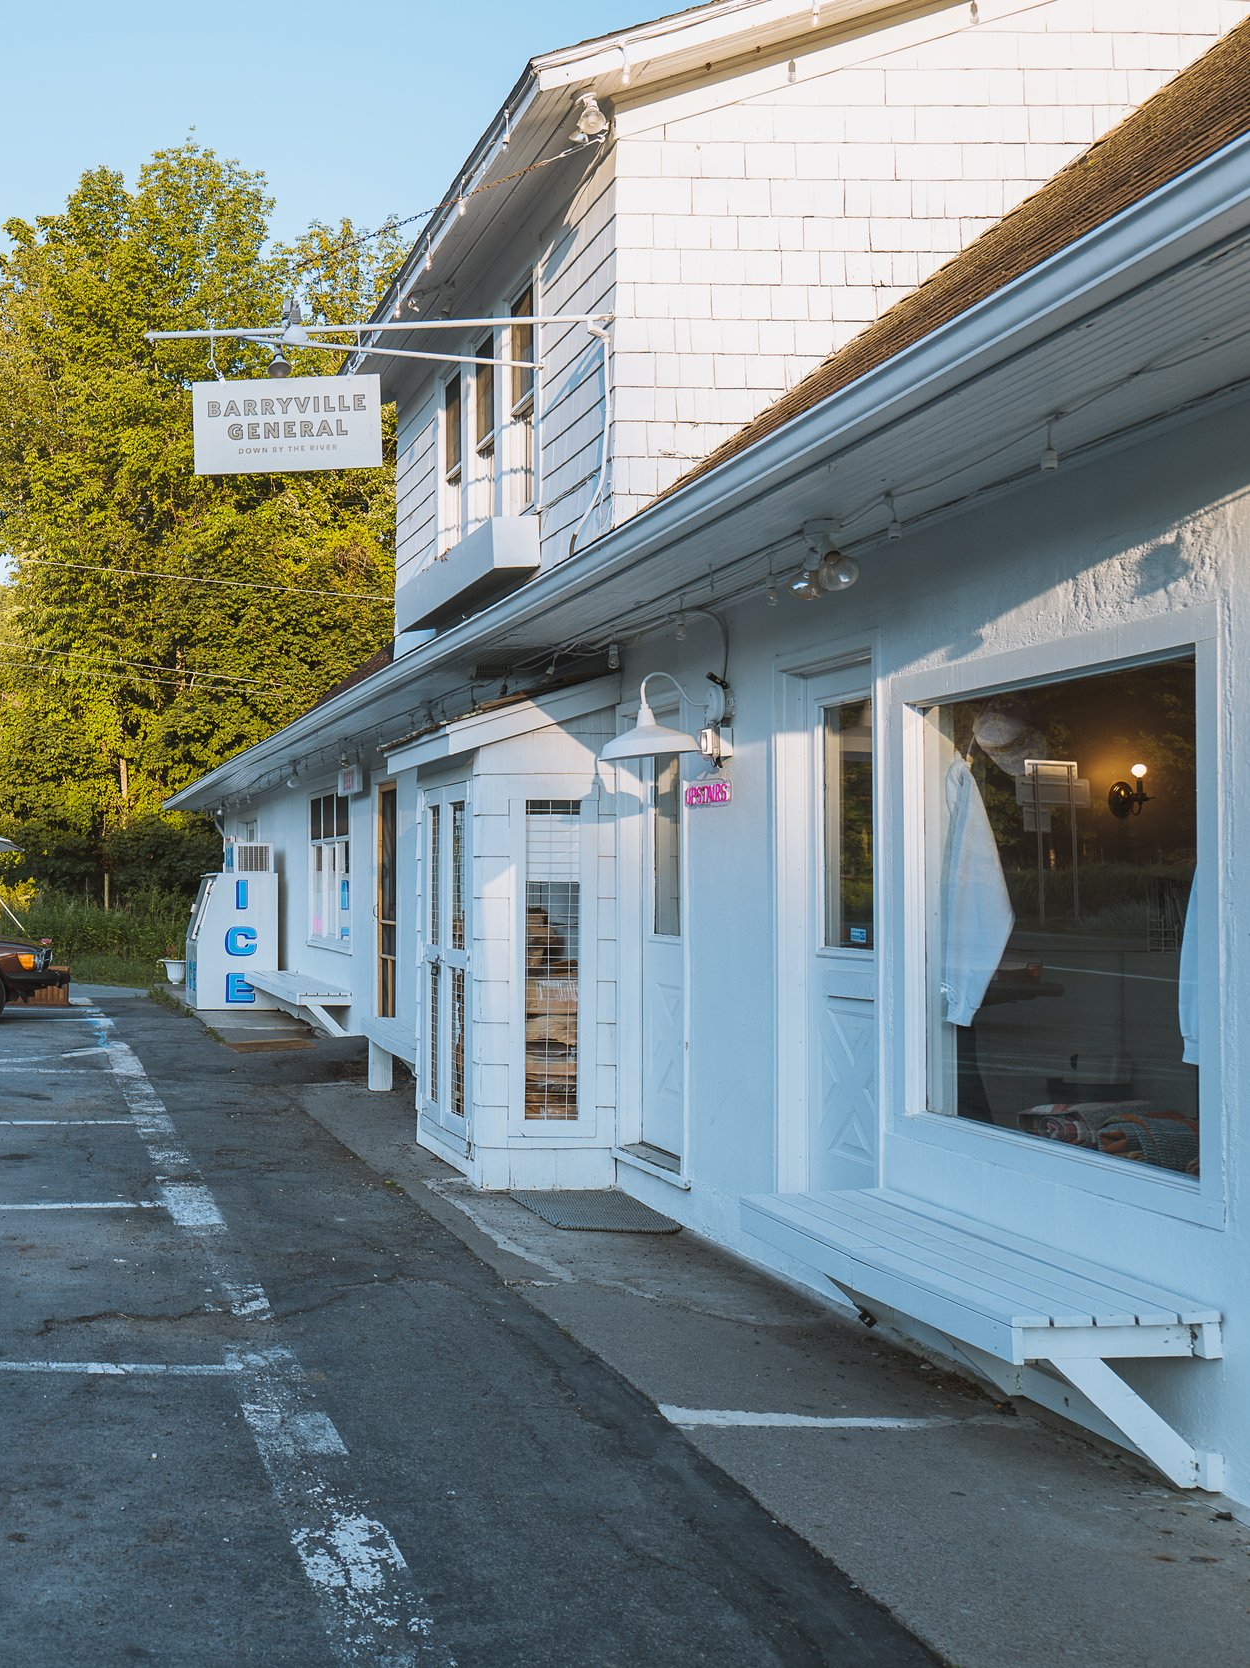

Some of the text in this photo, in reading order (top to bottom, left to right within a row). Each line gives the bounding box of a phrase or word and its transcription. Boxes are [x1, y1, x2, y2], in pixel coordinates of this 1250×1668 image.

[207, 393, 367, 418] BARRYVILLE
[227, 419, 349, 441] GENERAL
[238, 447, 268, 455] DOWN
[685, 783, 728, 805] UPSTAIRS
[224, 879, 258, 1003] ICE
